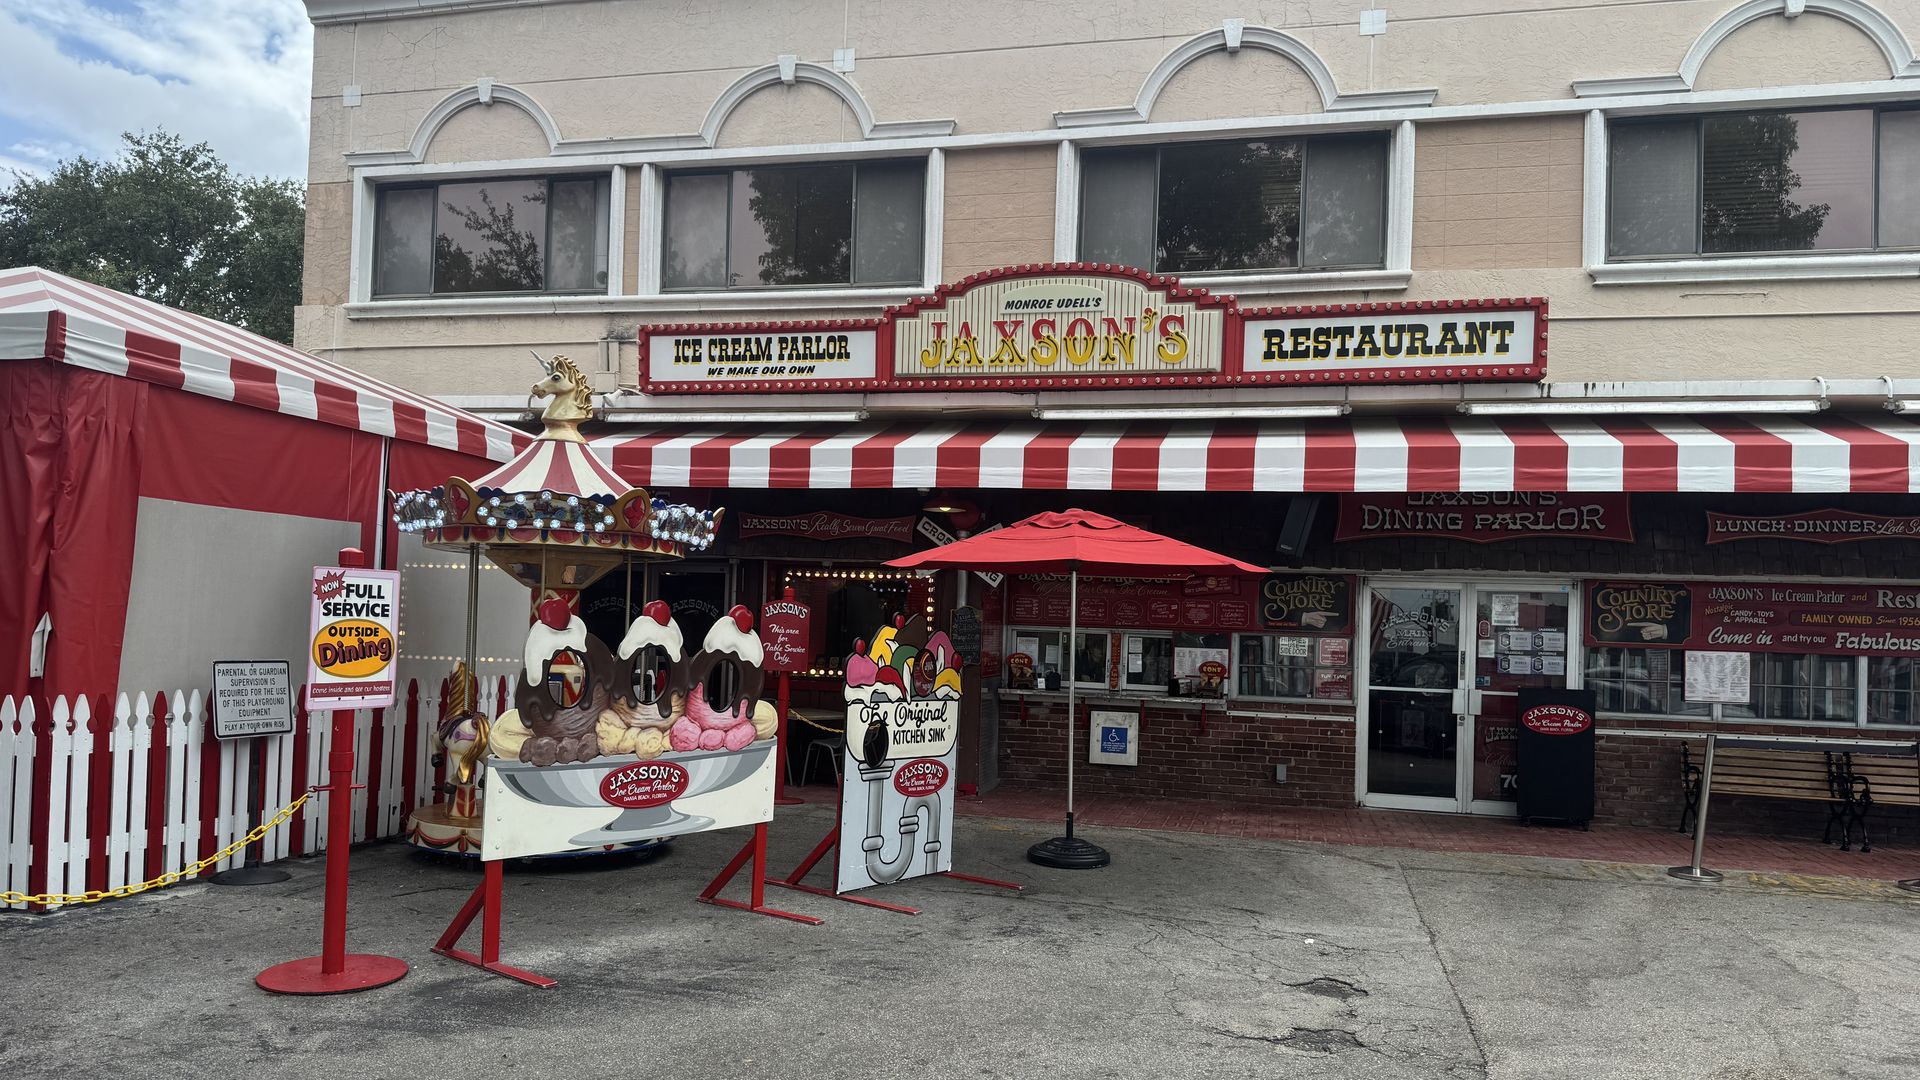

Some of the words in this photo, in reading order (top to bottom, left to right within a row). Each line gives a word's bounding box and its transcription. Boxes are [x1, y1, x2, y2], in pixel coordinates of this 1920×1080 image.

[1005, 299, 1053, 310] MONROE
[1056, 297, 1102, 309] UDELL'S
[920, 307, 1189, 368] JAXSON'S
[1262, 321, 1515, 362] RESTAURANT
[673, 339, 702, 366] ICE
[707, 337, 773, 364] CREAM
[777, 335, 850, 362] PARLOR
[706, 367, 724, 377] WE
[727, 366, 759, 377] MAKE
[761, 365, 786, 376] OUR
[789, 365, 816, 375] OWN
[1361, 504, 1464, 530] DINING
[1475, 504, 1607, 530] PARLOR
[742, 519, 809, 531] JAXSON'S
[1716, 520, 1785, 532] LUNCH
[1794, 520, 1878, 532] DINNER
[321, 580, 339, 593] NOW
[345, 584, 385, 599] FULL
[1264, 576, 1344, 599] COUNTRY
[1597, 584, 1687, 609] COUNTRY
[1708, 588, 1764, 601] JAXSON'S
[1772, 589, 1784, 601] Ice
[1785, 589, 1814, 602] Cream
[1816, 590, 1845, 603] Parlor
[1851, 593, 1867, 601] and
[322, 600, 390, 617] SERVICE
[765, 603, 808, 618] JAXSON'S
[1264, 594, 1335, 620] STORE
[1705, 602, 1733, 615] Nostalgic
[1757, 610, 1774, 618] TOYS
[1380, 611, 1450, 633] JAXSON'S
[1598, 603, 1676, 632] STORE
[1801, 614, 1834, 623] FAMILY
[1838, 615, 1872, 624] OWNED
[1899, 617, 1920, 626] 1956
[328, 626, 379, 637] OUTSIDE
[769, 624, 785, 633] This
[777, 634, 788, 643] for
[1387, 636, 1438, 648] Entrance
[1708, 626, 1753, 645] Come
[1755, 629, 1773, 645] in
[1782, 634, 1798, 643] and
[1800, 634, 1810, 644] try
[1813, 635, 1826, 643] our
[1834, 632, 1920, 650] Fabulous
[318, 638, 391, 668] Dining
[763, 642, 783, 651] Table
[784, 644, 805, 653] Service
[249, 668, 257, 676] OR
[259, 668, 287, 676] GUARDIAN
[230, 678, 269, 687] SUPERVISION
[219, 689, 249, 698] REQUIRED
[250, 688, 261, 696] FOR
[264, 688, 274, 696] THE
[275, 687, 287, 695] USE
[222, 700, 230, 708] OF
[233, 699, 245, 707] THIS
[247, 697, 284, 706] PLAYGROUND
[239, 708, 271, 717] EQUIPMENT
[860, 703, 889, 726] The
[894, 700, 947, 728] Original
[1528, 707, 1585, 721] JAXSON'S
[262, 721, 273, 729] OWN
[274, 721, 285, 729] RISK
[1541, 719, 1562, 727] Cream
[1563, 719, 1582, 728] Parlor
[893, 729, 925, 745] KITCHEN
[928, 728, 946, 743] SINK
[1485, 726, 1518, 742] JAX
[610, 766, 681, 789] JAXSON'S
[899, 763, 944, 783] JAXSON'S
[610, 788, 626, 798] Ice
[627, 783, 651, 795] Cream
[653, 780, 679, 793] Parlor
